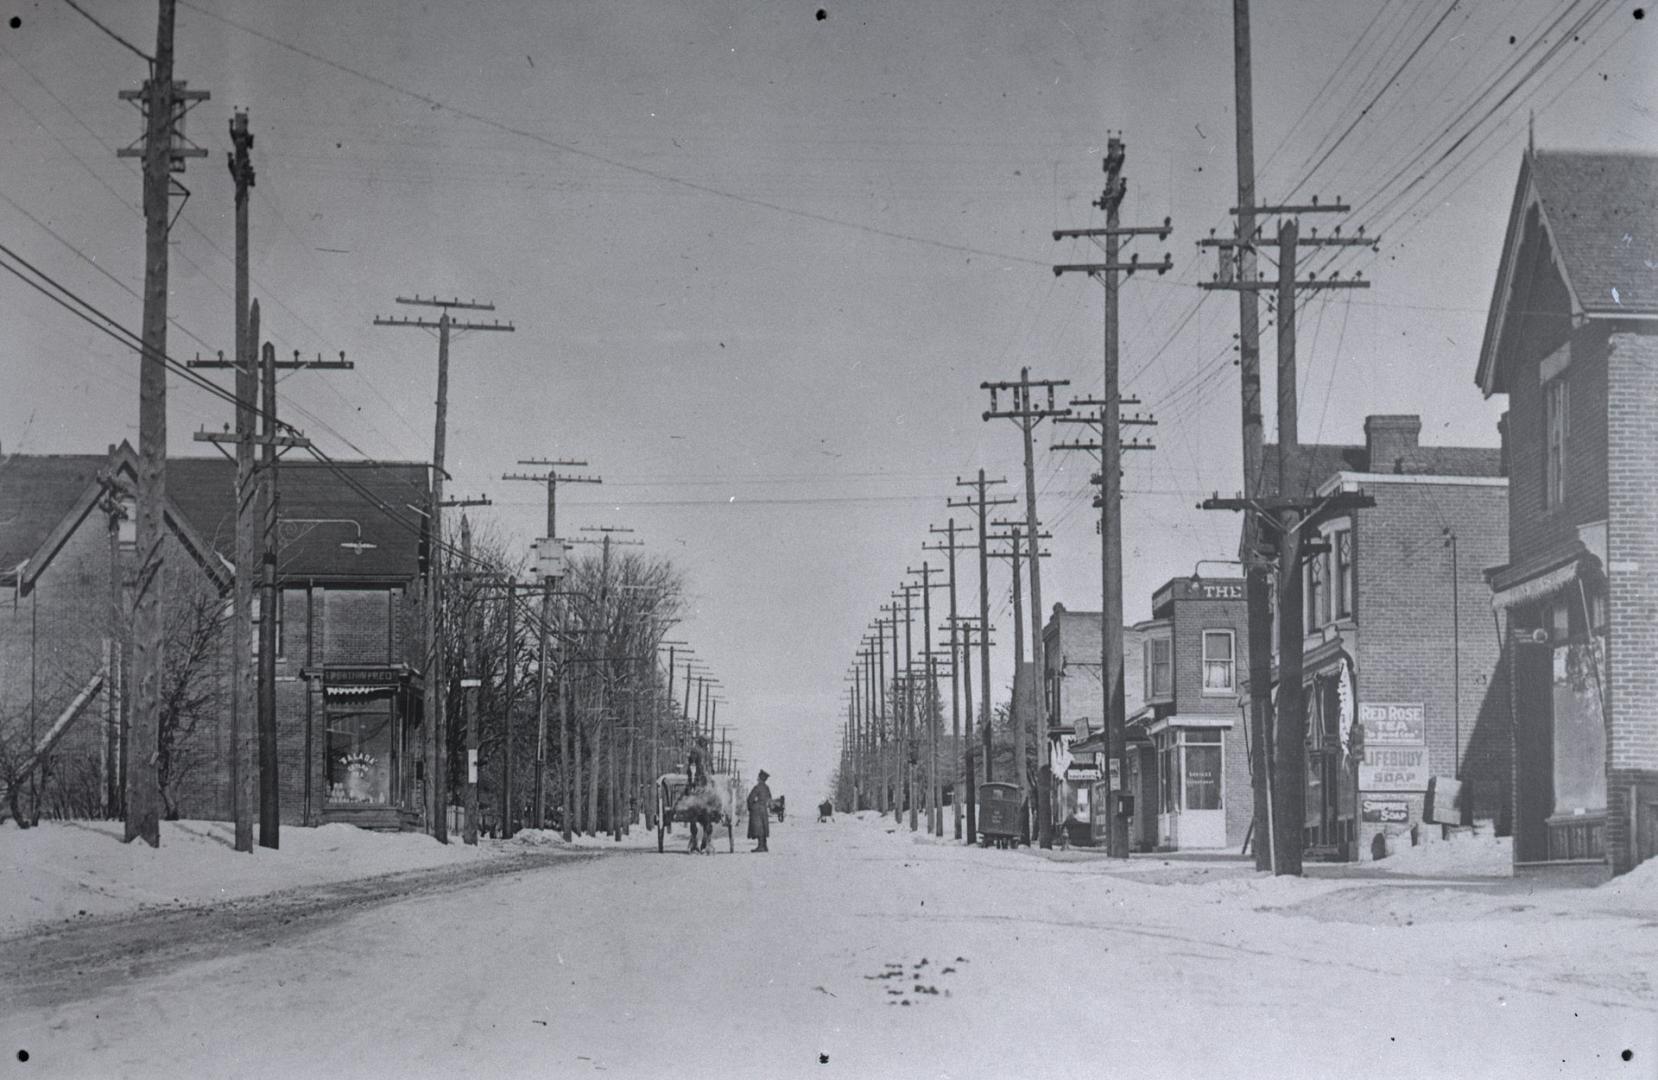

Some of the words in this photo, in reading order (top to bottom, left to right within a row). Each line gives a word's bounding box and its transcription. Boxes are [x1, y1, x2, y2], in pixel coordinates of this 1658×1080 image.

[1203, 585, 1242, 598] THE
[1361, 706, 1386, 720] RED
[1388, 706, 1422, 720] ROSE
[1375, 721, 1408, 731] TEA
[1364, 751, 1423, 766] LIFEBUOY
[1374, 773, 1415, 782] SOAP
[1380, 810, 1407, 821] SOAP
